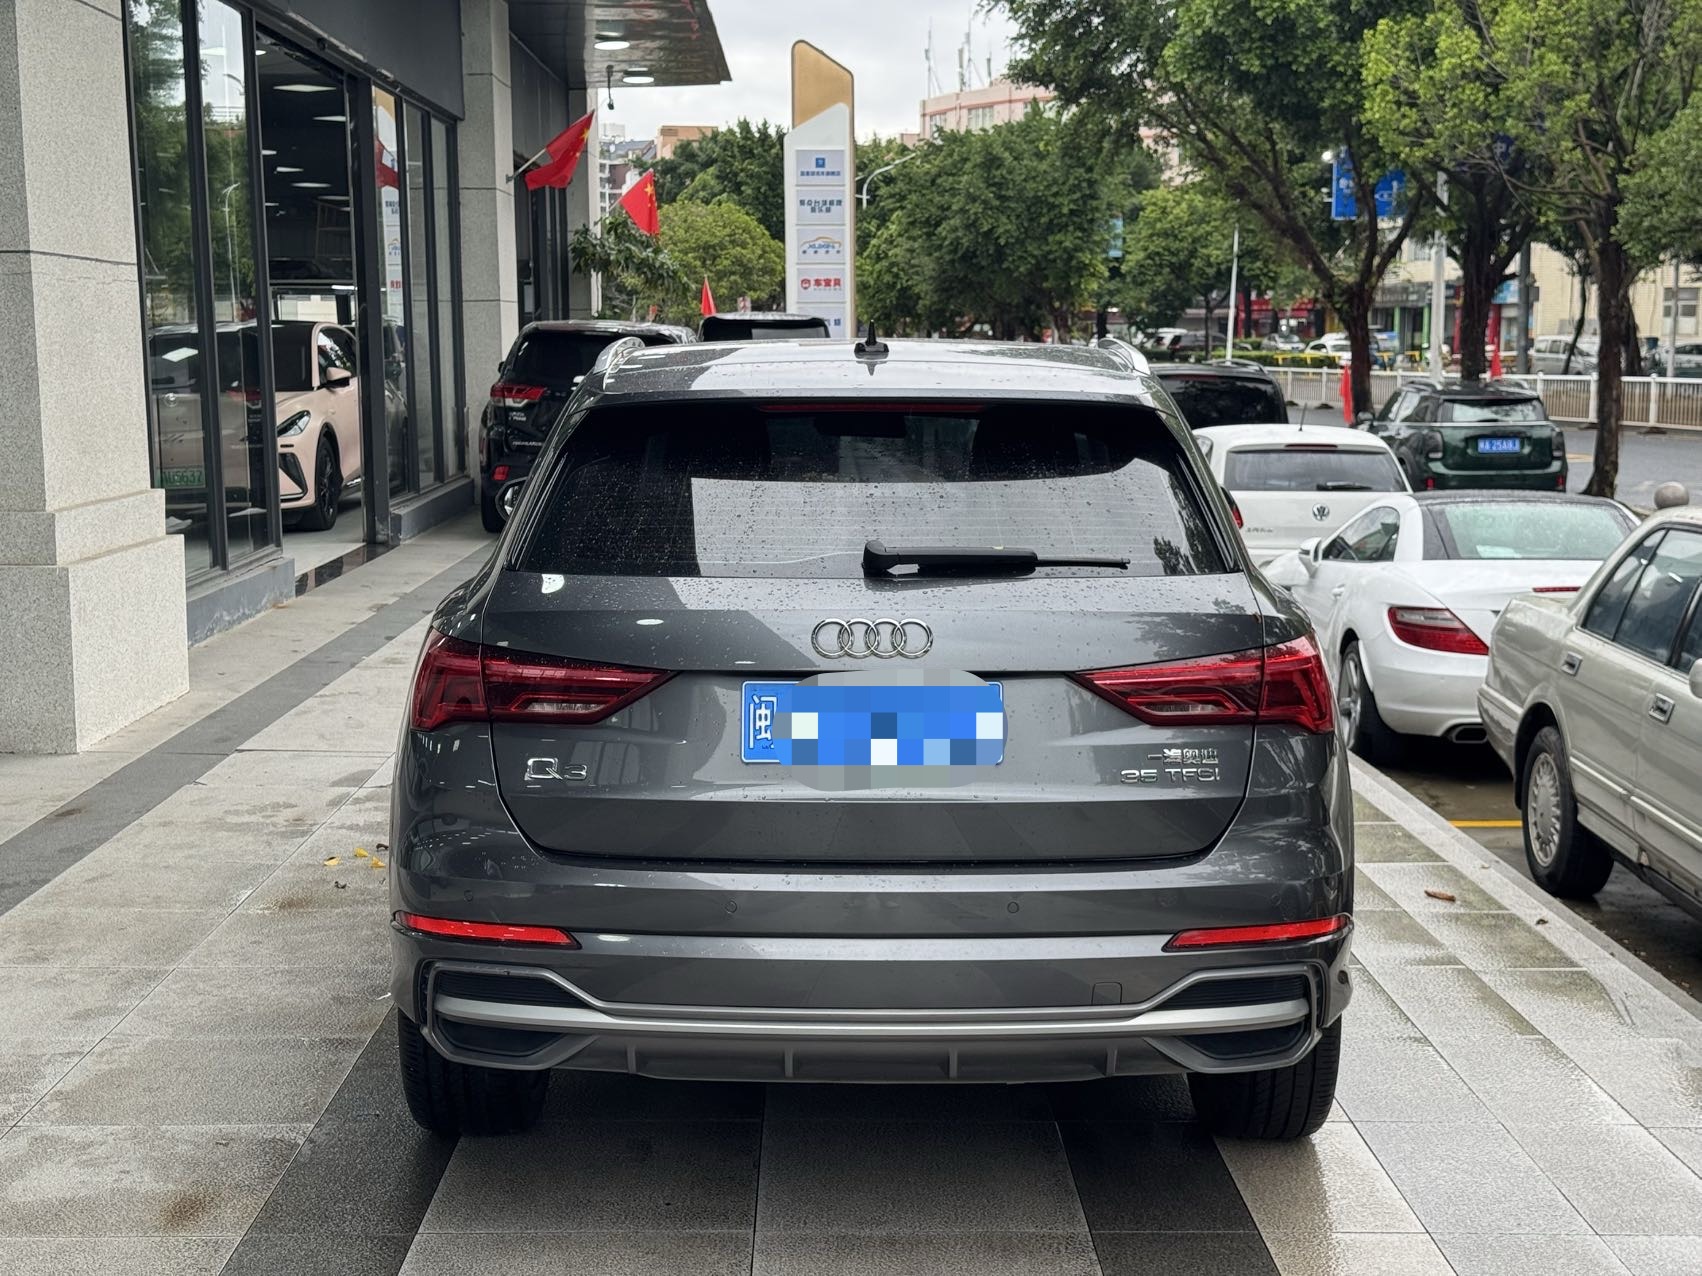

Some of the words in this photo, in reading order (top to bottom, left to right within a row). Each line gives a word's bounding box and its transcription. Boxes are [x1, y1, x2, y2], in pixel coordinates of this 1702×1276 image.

[525, 758, 587, 780] Q3
[1121, 769, 1157, 783] 35
[1165, 767, 1219, 781] TFSI
